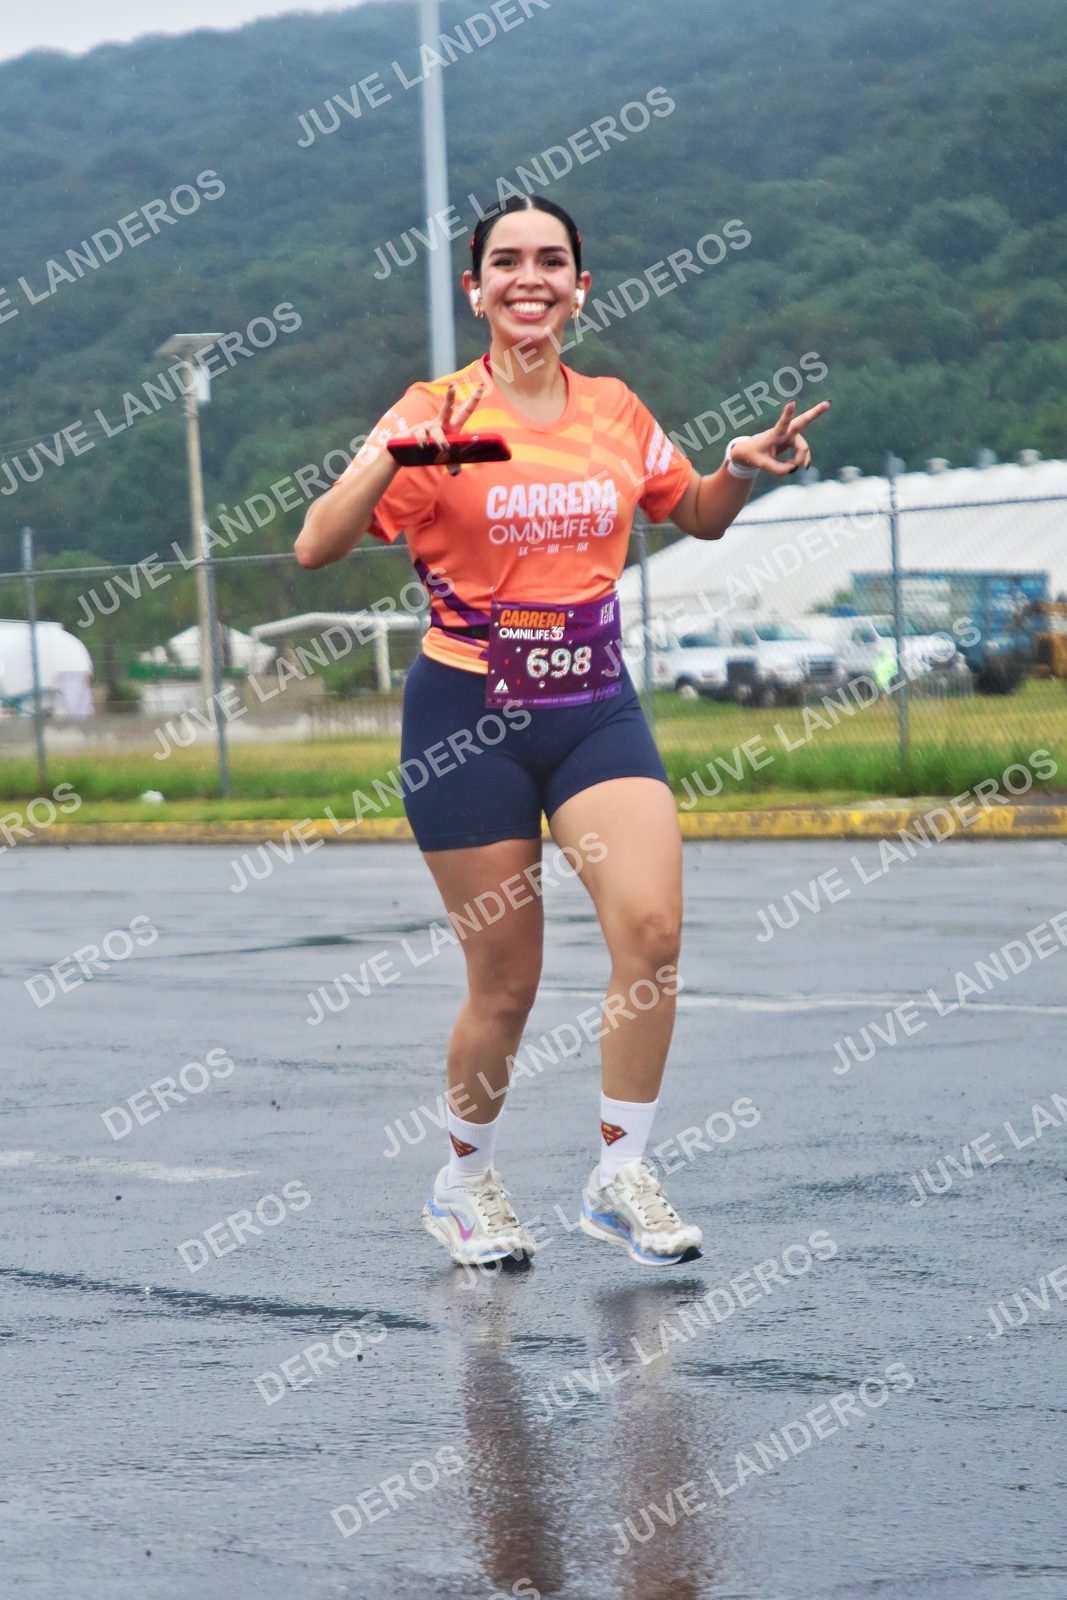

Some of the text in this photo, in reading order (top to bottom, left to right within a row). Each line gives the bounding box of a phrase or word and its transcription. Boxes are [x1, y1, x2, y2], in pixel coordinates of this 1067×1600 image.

[486, 478, 618, 520] CARRERA
[499, 609, 567, 628] CARRERA
[526, 645, 592, 679] 698
